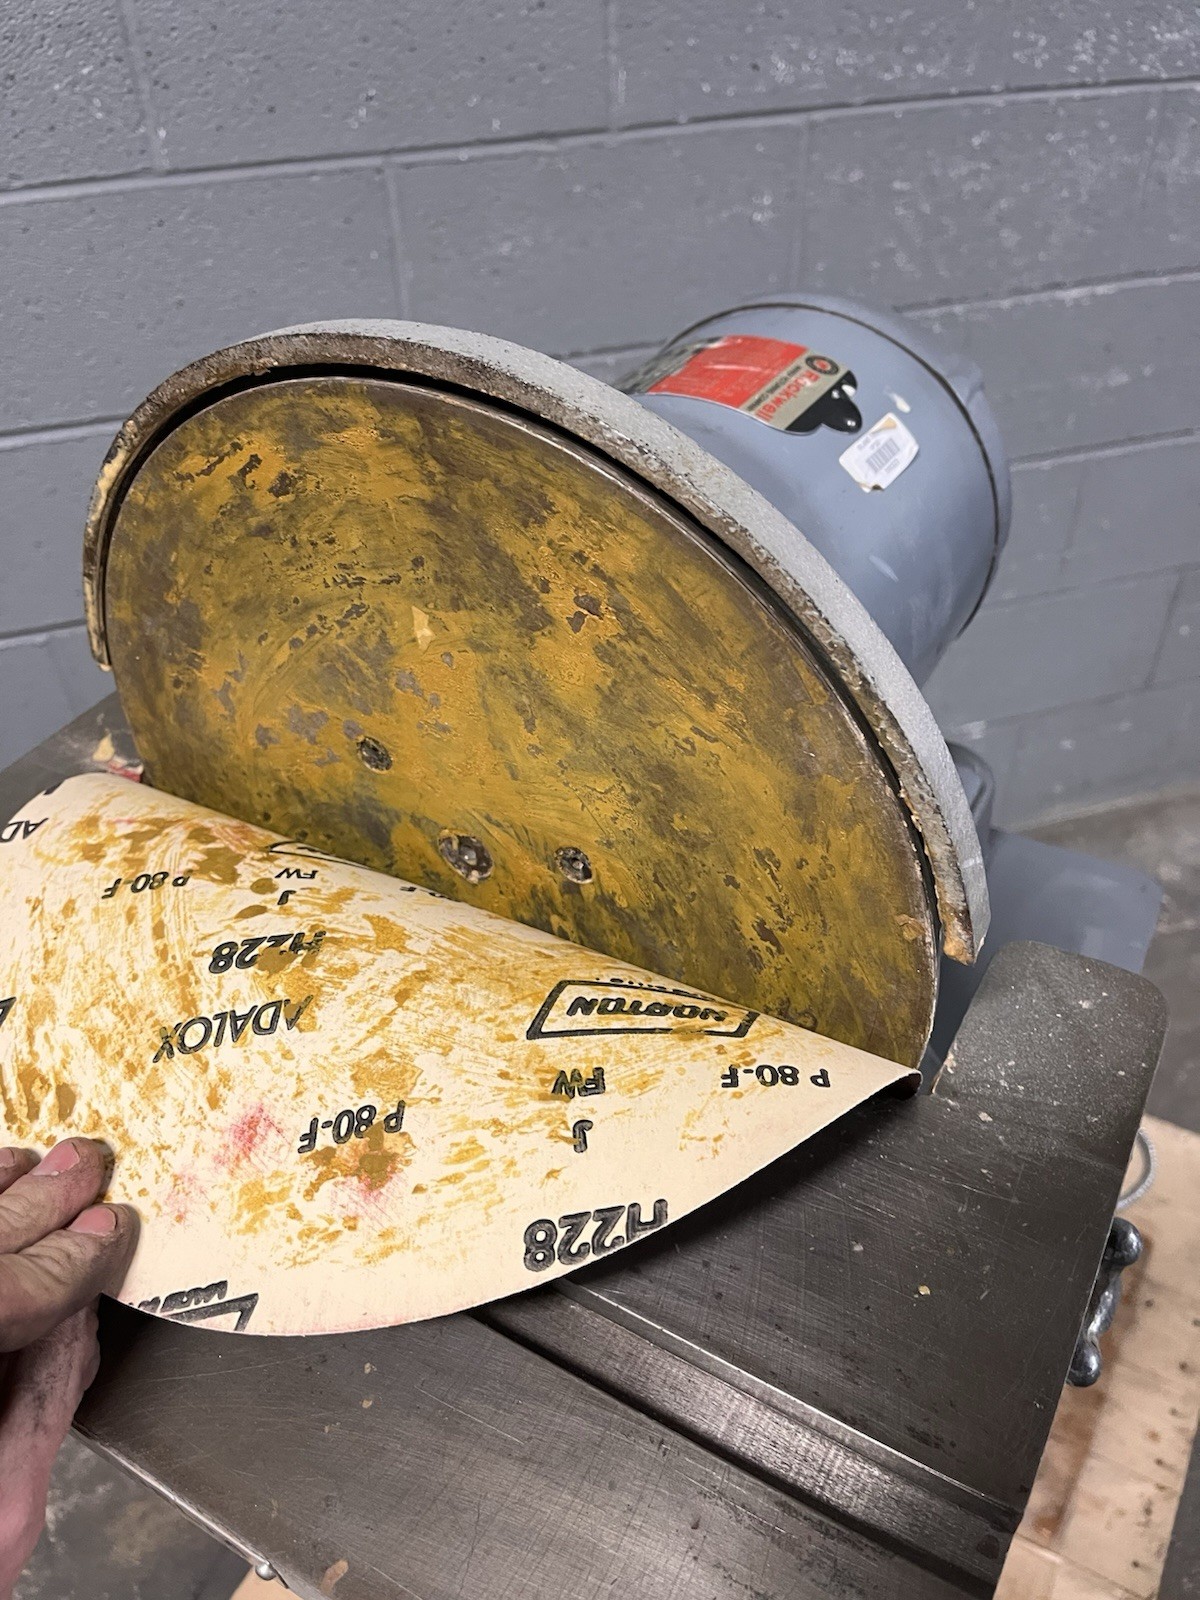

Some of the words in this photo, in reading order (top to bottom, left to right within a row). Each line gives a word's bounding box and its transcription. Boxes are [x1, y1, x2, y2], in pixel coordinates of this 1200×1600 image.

[756, 370, 821, 421] Rockwell
[101, 871, 168, 899] 80-F
[172, 876, 191, 887] P
[275, 867, 319, 880] FW
[277, 890, 297, 906] J
[566, 995, 730, 1023] NORTON
[152, 995, 313, 1063] ADALOX
[552, 1066, 606, 1098] FW
[721, 1065, 799, 1088] 80-F
[811, 1069, 831, 1088] P
[297, 1104, 377, 1154] 80-F
[383, 1100, 406, 1134] P
[572, 1120, 593, 1153] J
